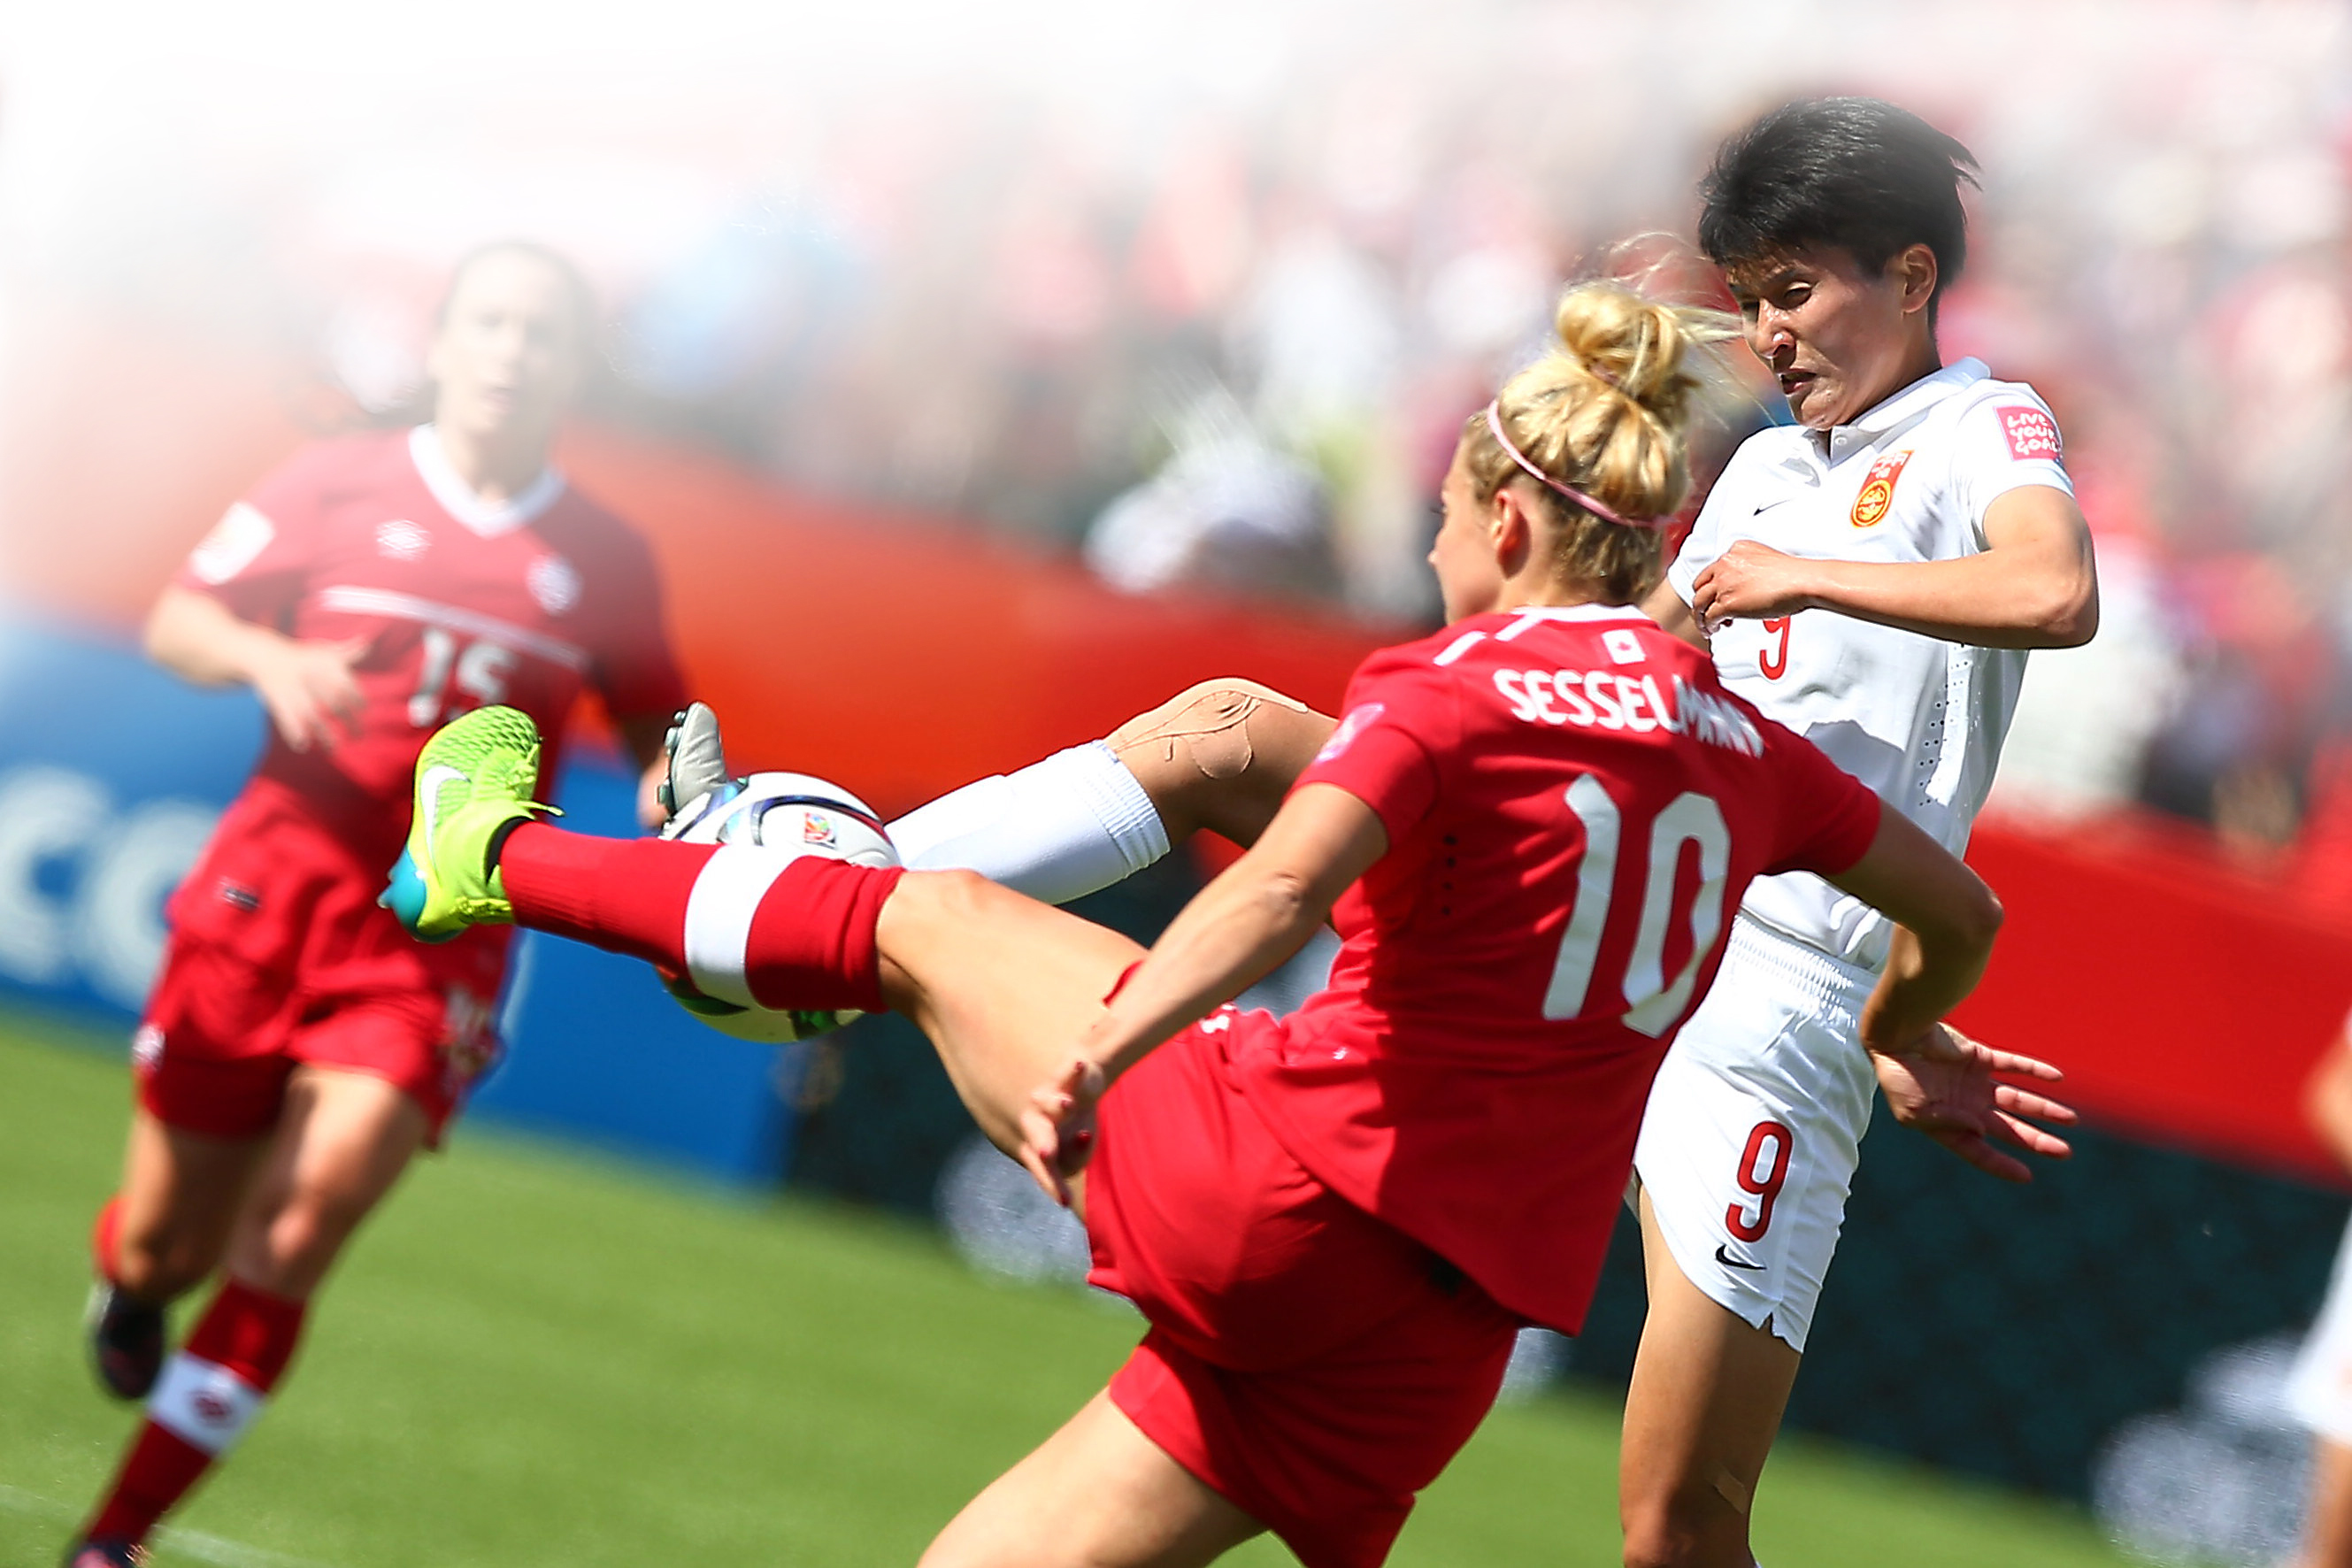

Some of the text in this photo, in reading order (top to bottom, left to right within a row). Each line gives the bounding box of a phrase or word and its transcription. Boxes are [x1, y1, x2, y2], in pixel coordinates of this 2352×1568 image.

[2007, 412, 2048, 428] LIVE
[2015, 438, 2058, 455] GOAL
[1541, 772, 1731, 1039] 10
[1726, 1120, 1793, 1242] 9
